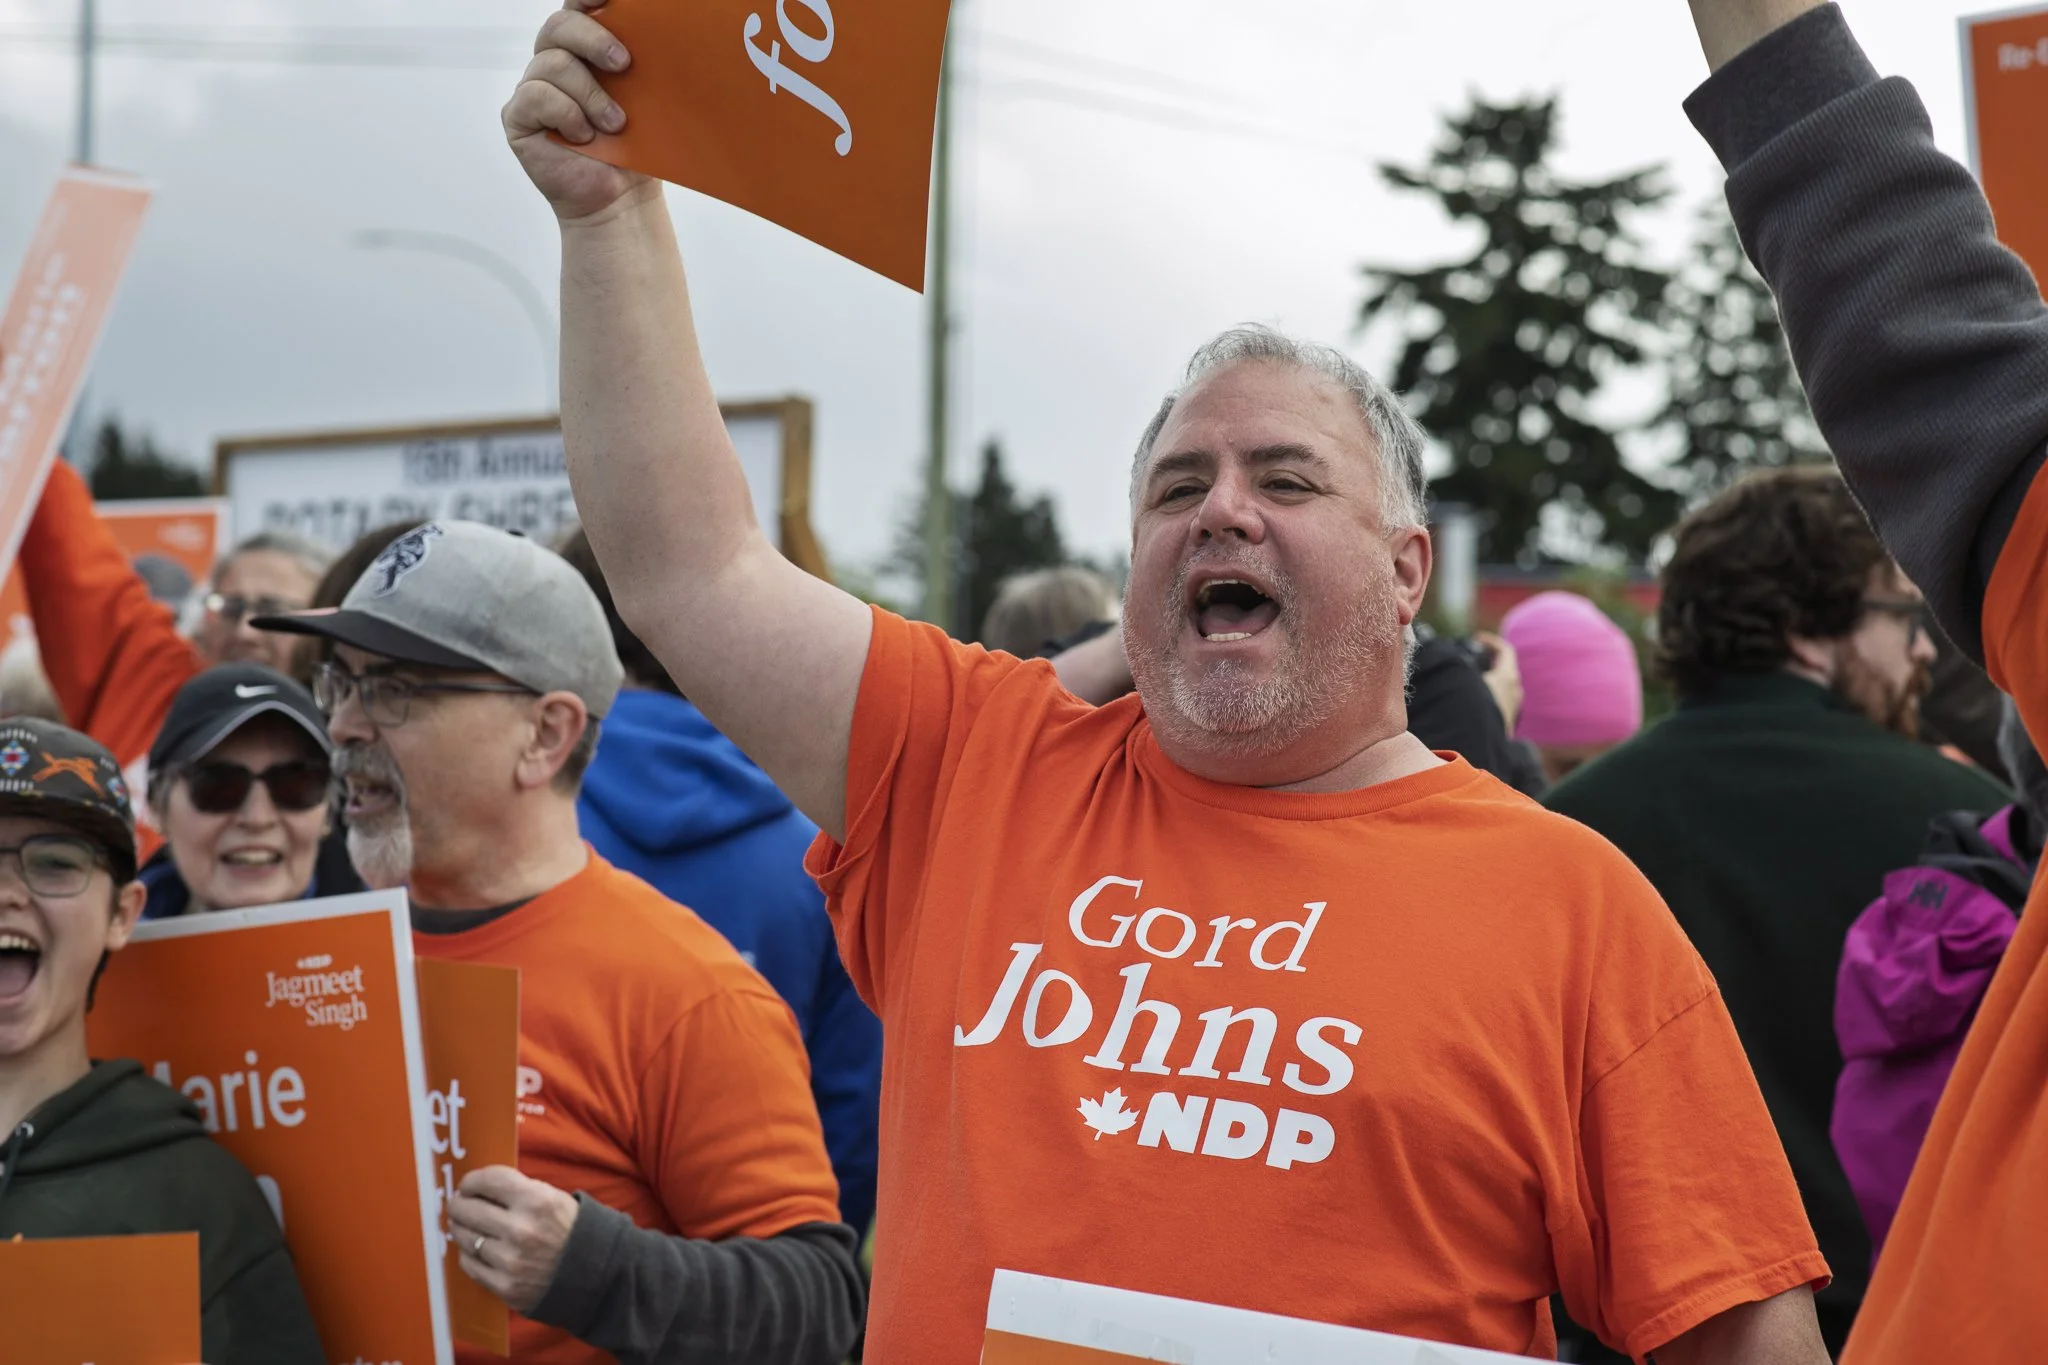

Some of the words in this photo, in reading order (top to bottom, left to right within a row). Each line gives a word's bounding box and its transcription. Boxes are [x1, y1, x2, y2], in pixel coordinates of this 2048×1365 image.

[1068, 875, 1328, 973] Gord
[265, 964, 365, 1008] Jagmeet
[304, 993, 368, 1031] Singh
[953, 942, 1364, 1096] Johns
[153, 1049, 306, 1135] arie
[1136, 1091, 1336, 1171] NDP
